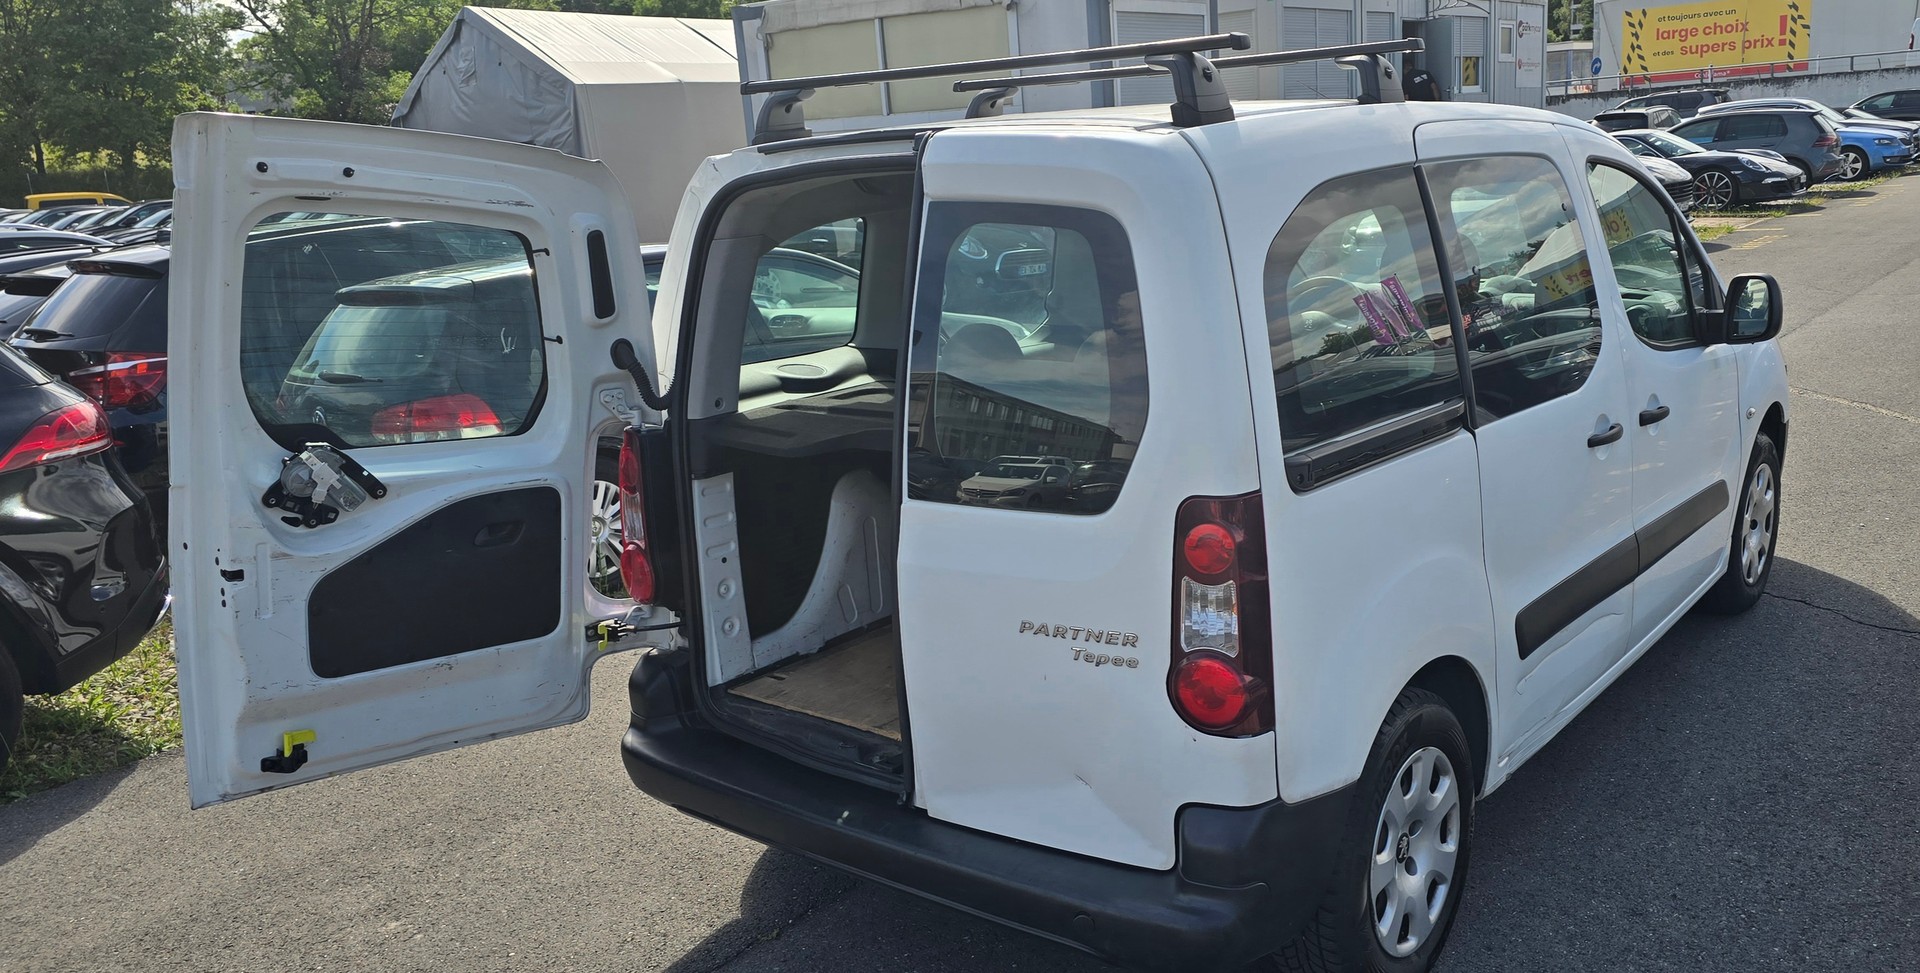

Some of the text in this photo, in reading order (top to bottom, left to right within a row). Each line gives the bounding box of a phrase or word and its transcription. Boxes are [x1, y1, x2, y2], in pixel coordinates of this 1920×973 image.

[1667, 12, 1701, 22] toujours
[1656, 19, 1749, 42] large choix
[1680, 40, 1736, 58] supers
[1742, 34, 1775, 54] prix
[1019, 619, 1139, 648] PARTNER
[1070, 646, 1139, 668] Tepee
